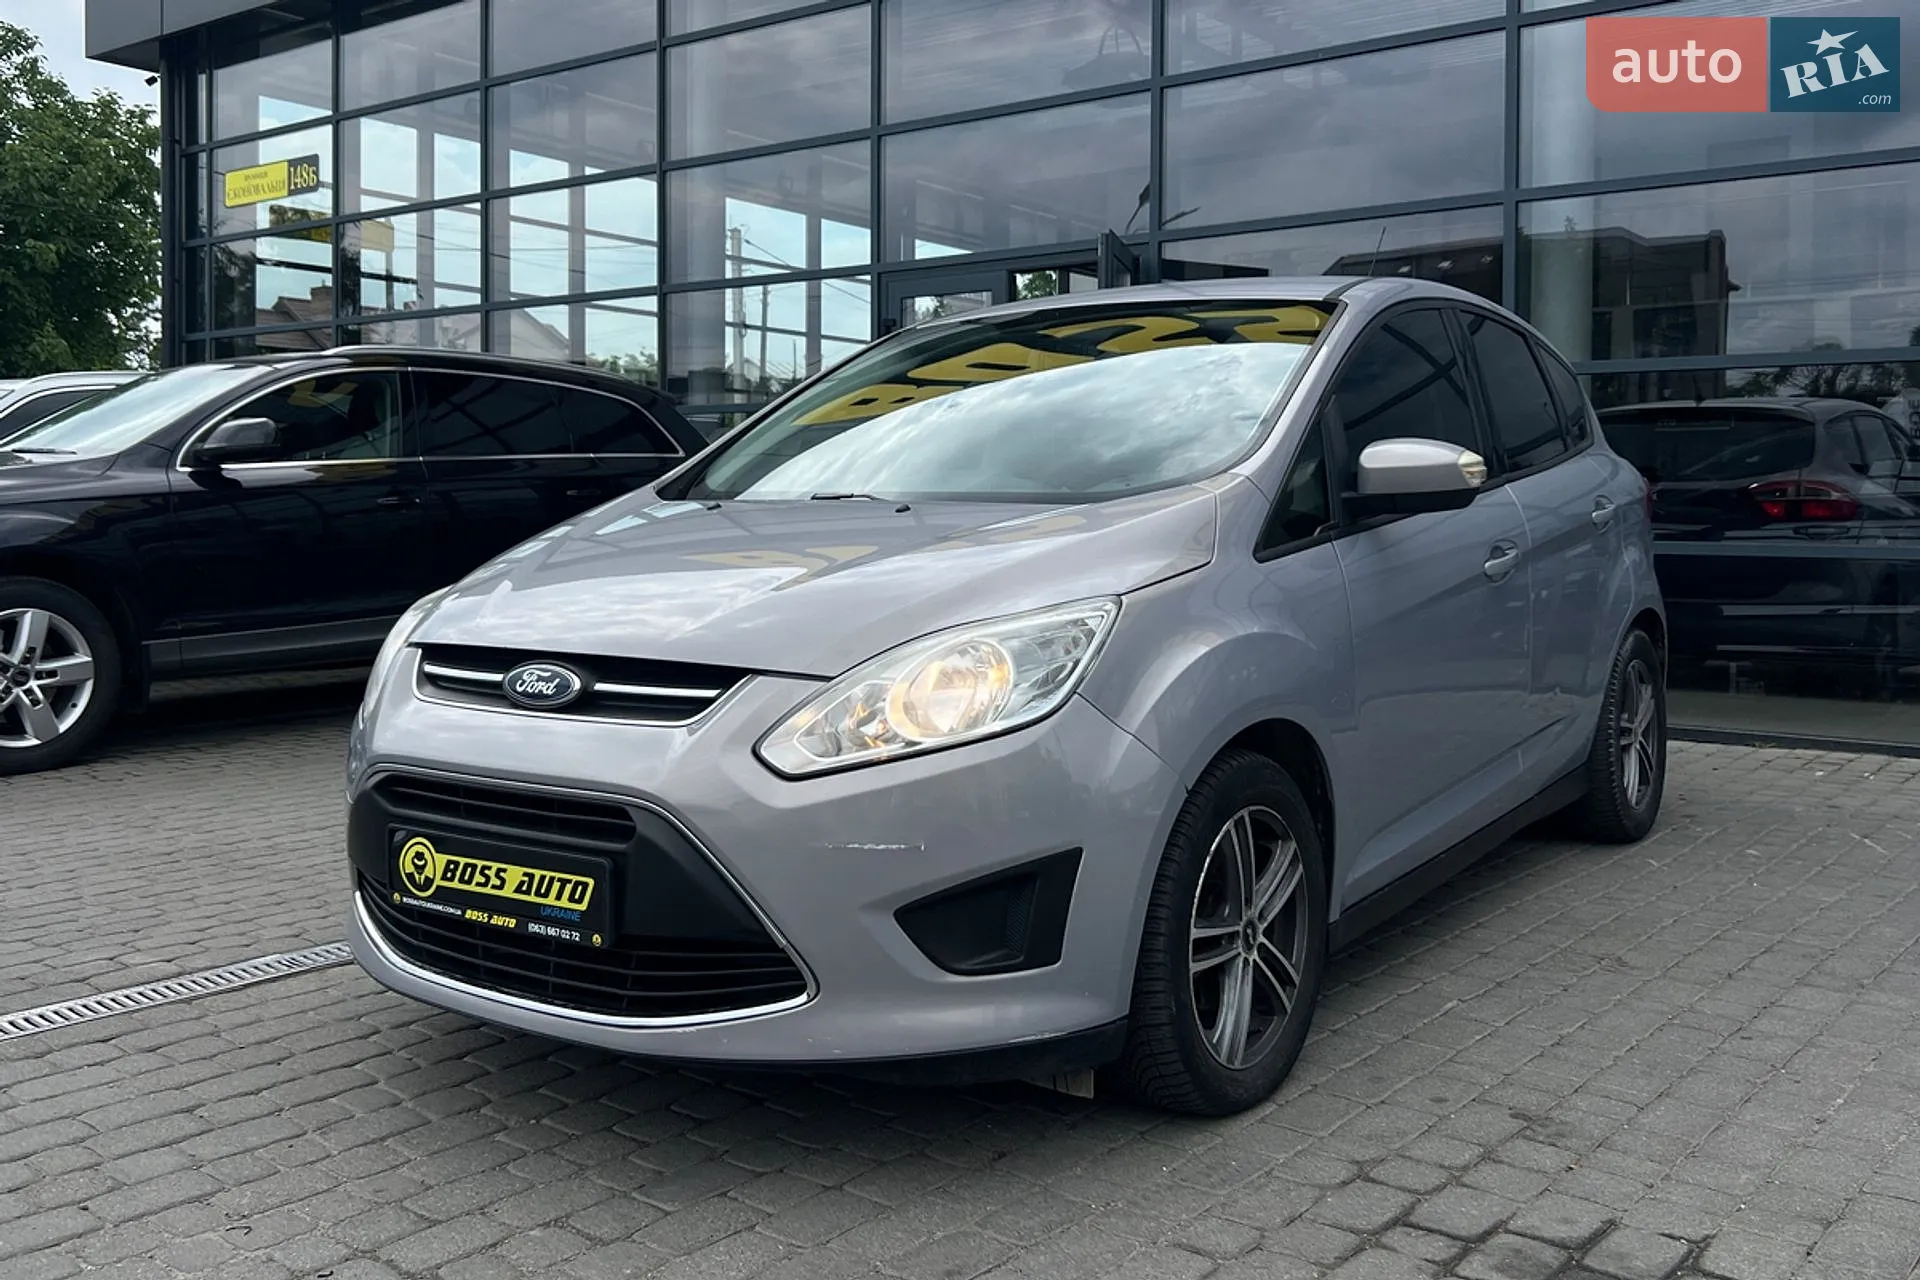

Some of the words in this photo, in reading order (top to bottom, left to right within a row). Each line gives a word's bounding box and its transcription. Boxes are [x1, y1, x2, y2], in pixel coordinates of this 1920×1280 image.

[516, 669, 560, 695] Ford
[440, 859, 508, 891] BOSS
[513, 872, 590, 905] AUTO
[464, 909, 489, 923] BOSS
[490, 915, 517, 928] AUTO
[541, 905, 581, 921] UKRAINE
